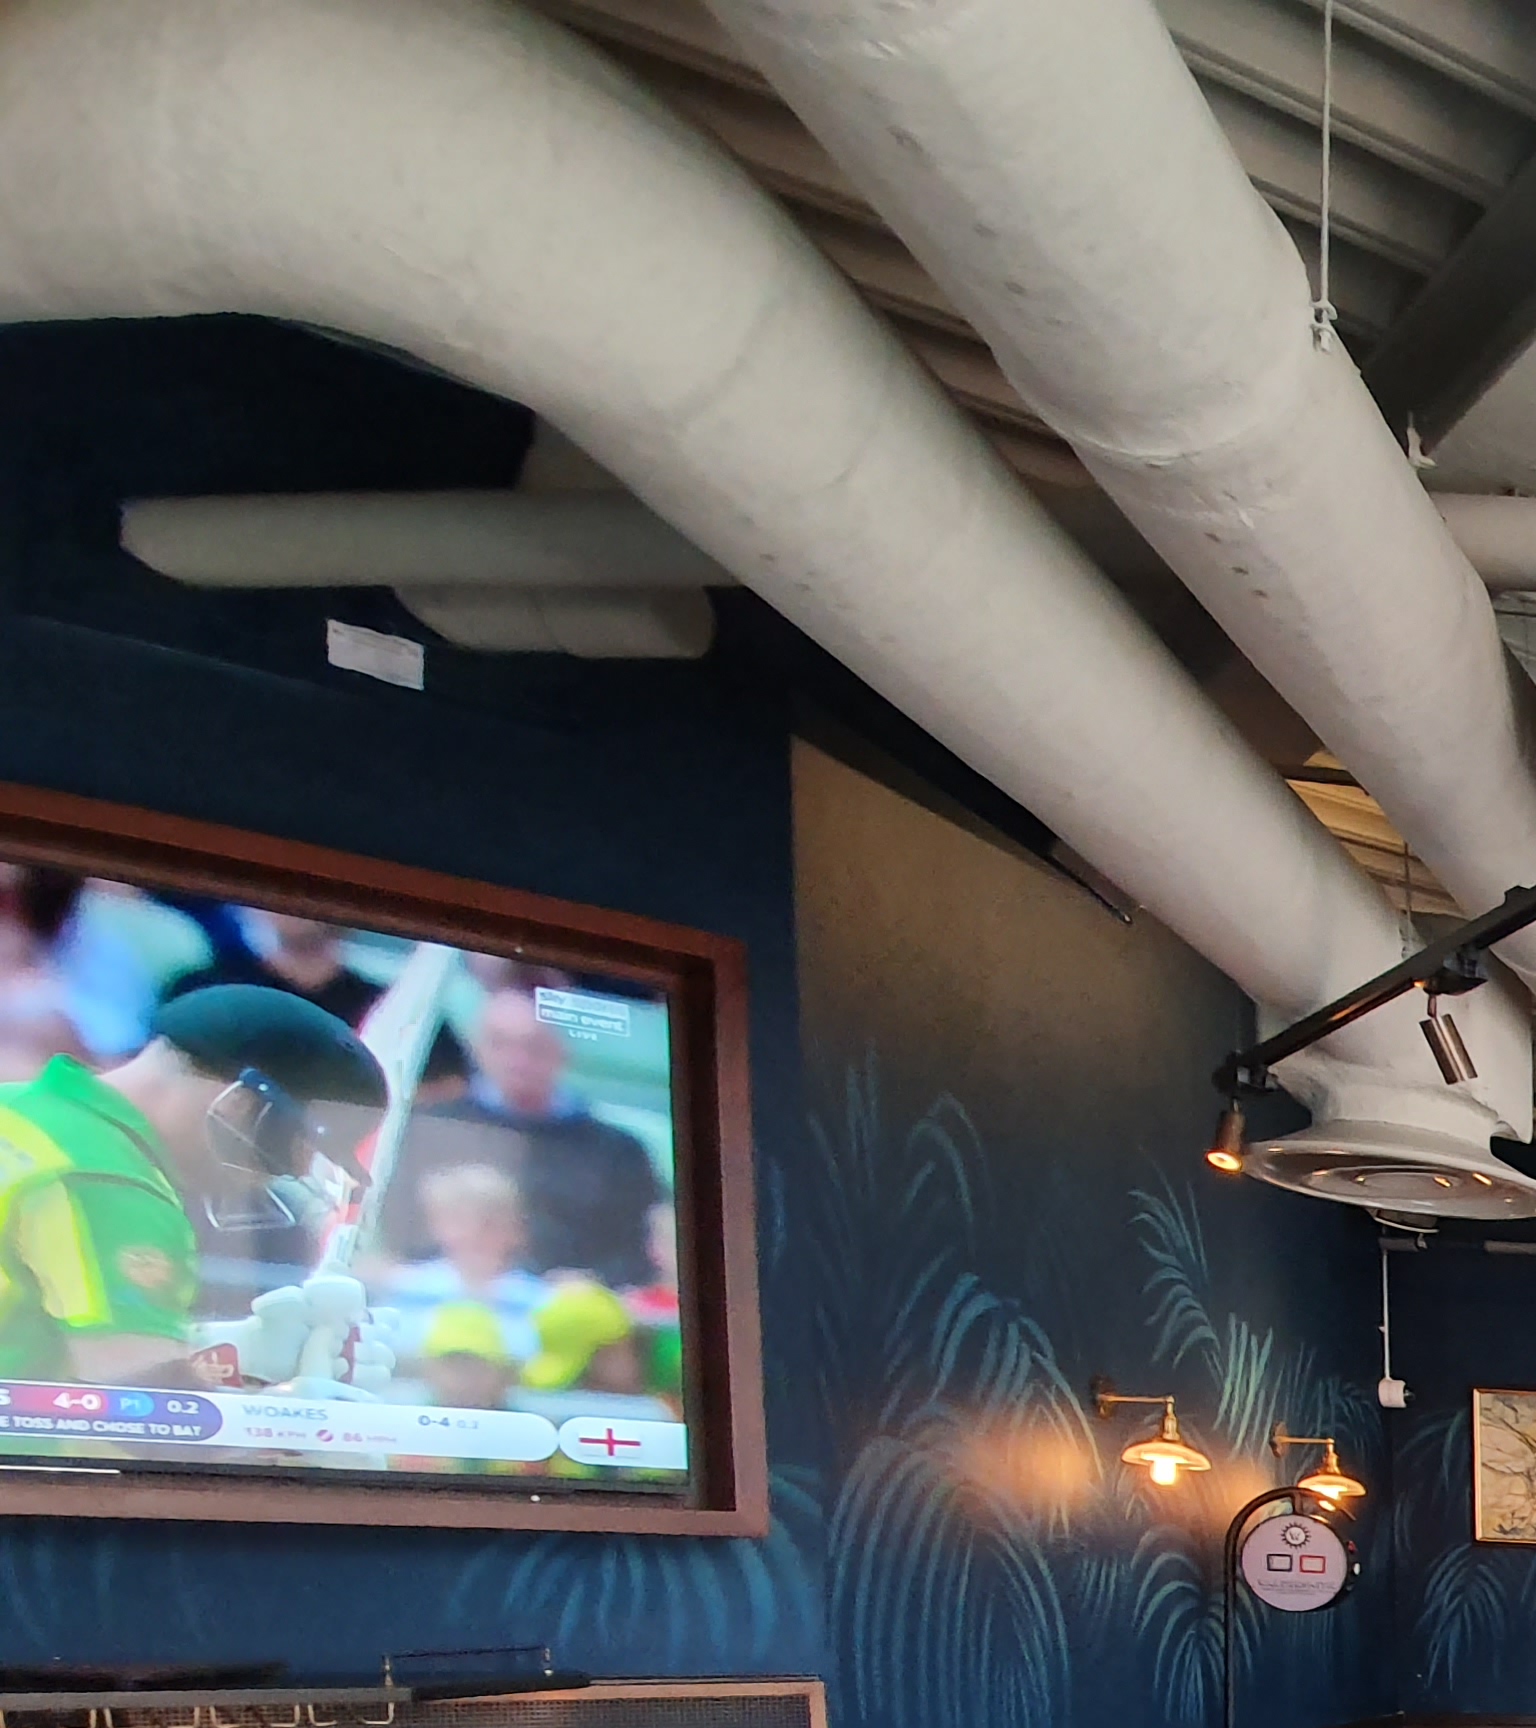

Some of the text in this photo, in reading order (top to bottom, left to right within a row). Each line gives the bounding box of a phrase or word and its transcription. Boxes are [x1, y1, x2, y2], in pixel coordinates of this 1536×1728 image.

[241, 1404, 329, 1421] WOAKES
[12, 1415, 54, 1430] TOSS
[56, 1418, 91, 1432] AND
[93, 1420, 145, 1435] CHOSE
[148, 1423, 171, 1435] TO
